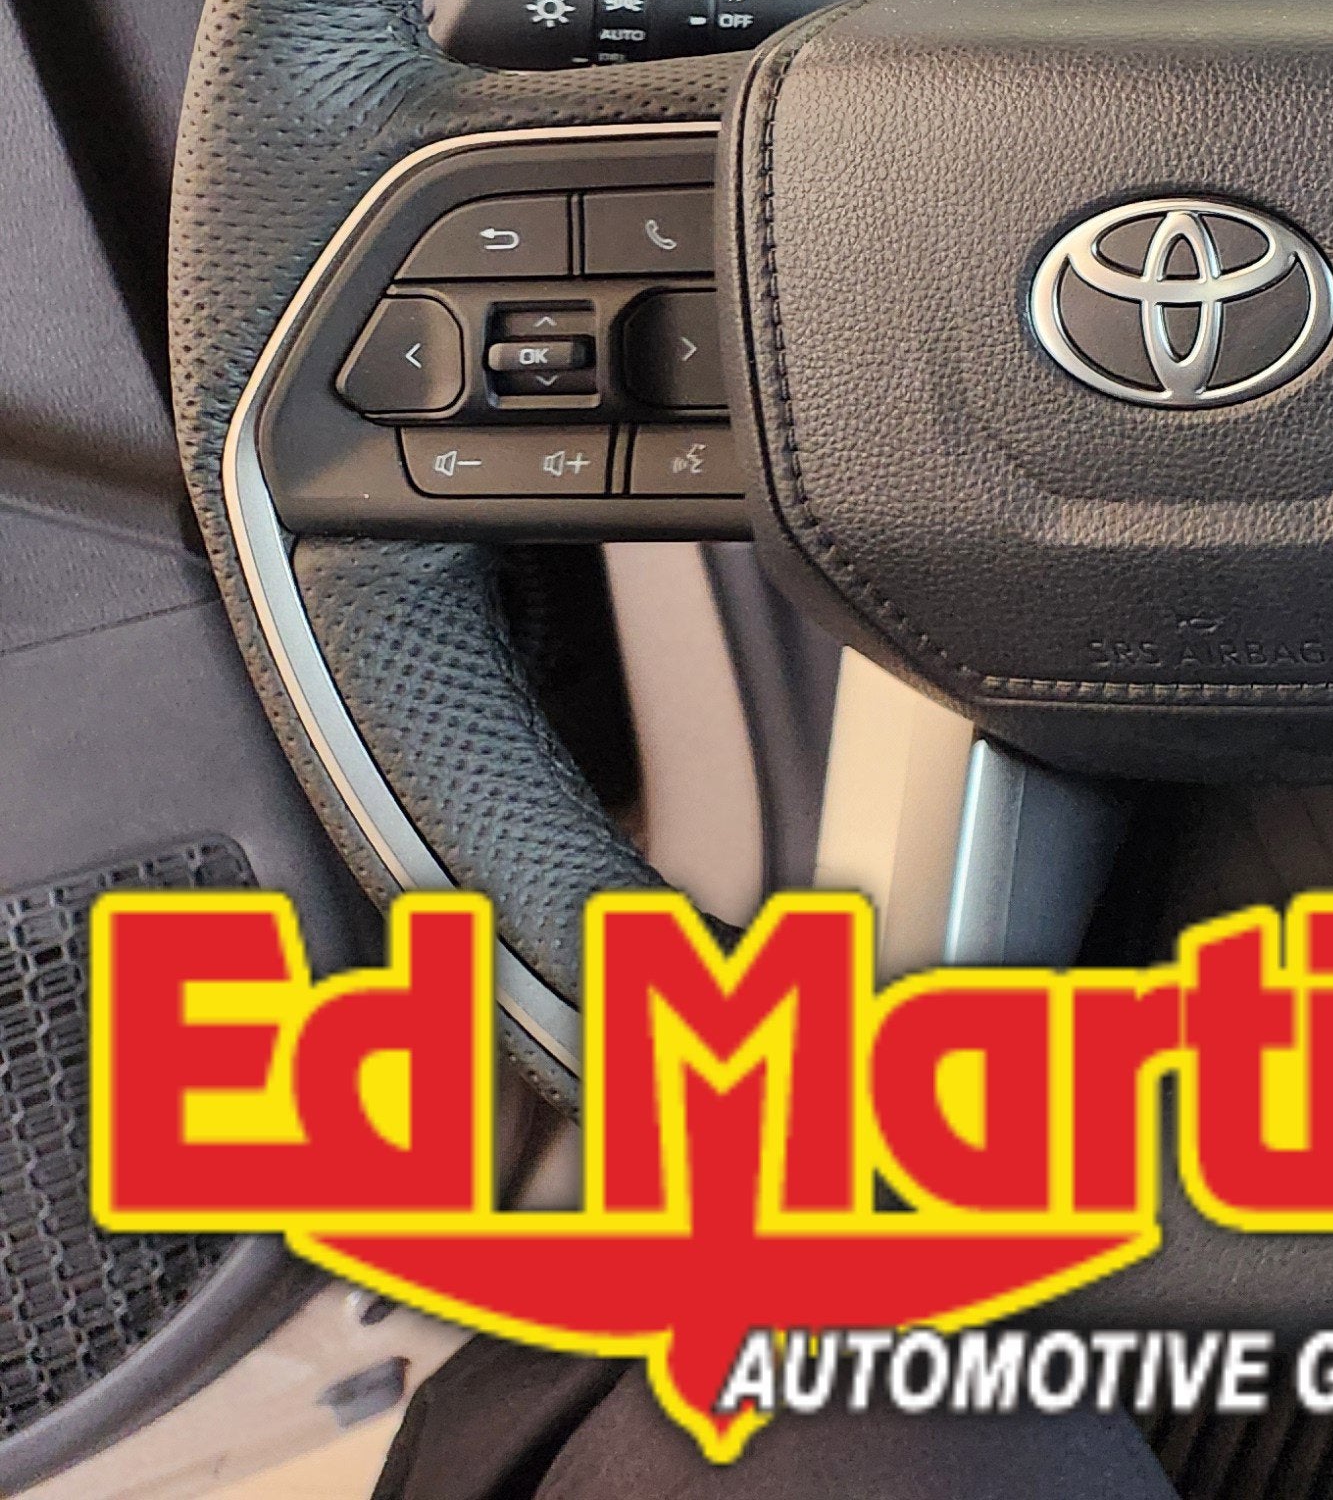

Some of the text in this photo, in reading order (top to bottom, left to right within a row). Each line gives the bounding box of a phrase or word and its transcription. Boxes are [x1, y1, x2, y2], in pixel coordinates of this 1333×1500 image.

[718, 12, 754, 28] OFF
[600, 29, 646, 41] AUTO
[519, 348, 550, 365] OK
[1088, 639, 1327, 668] SRS AIRBAG
